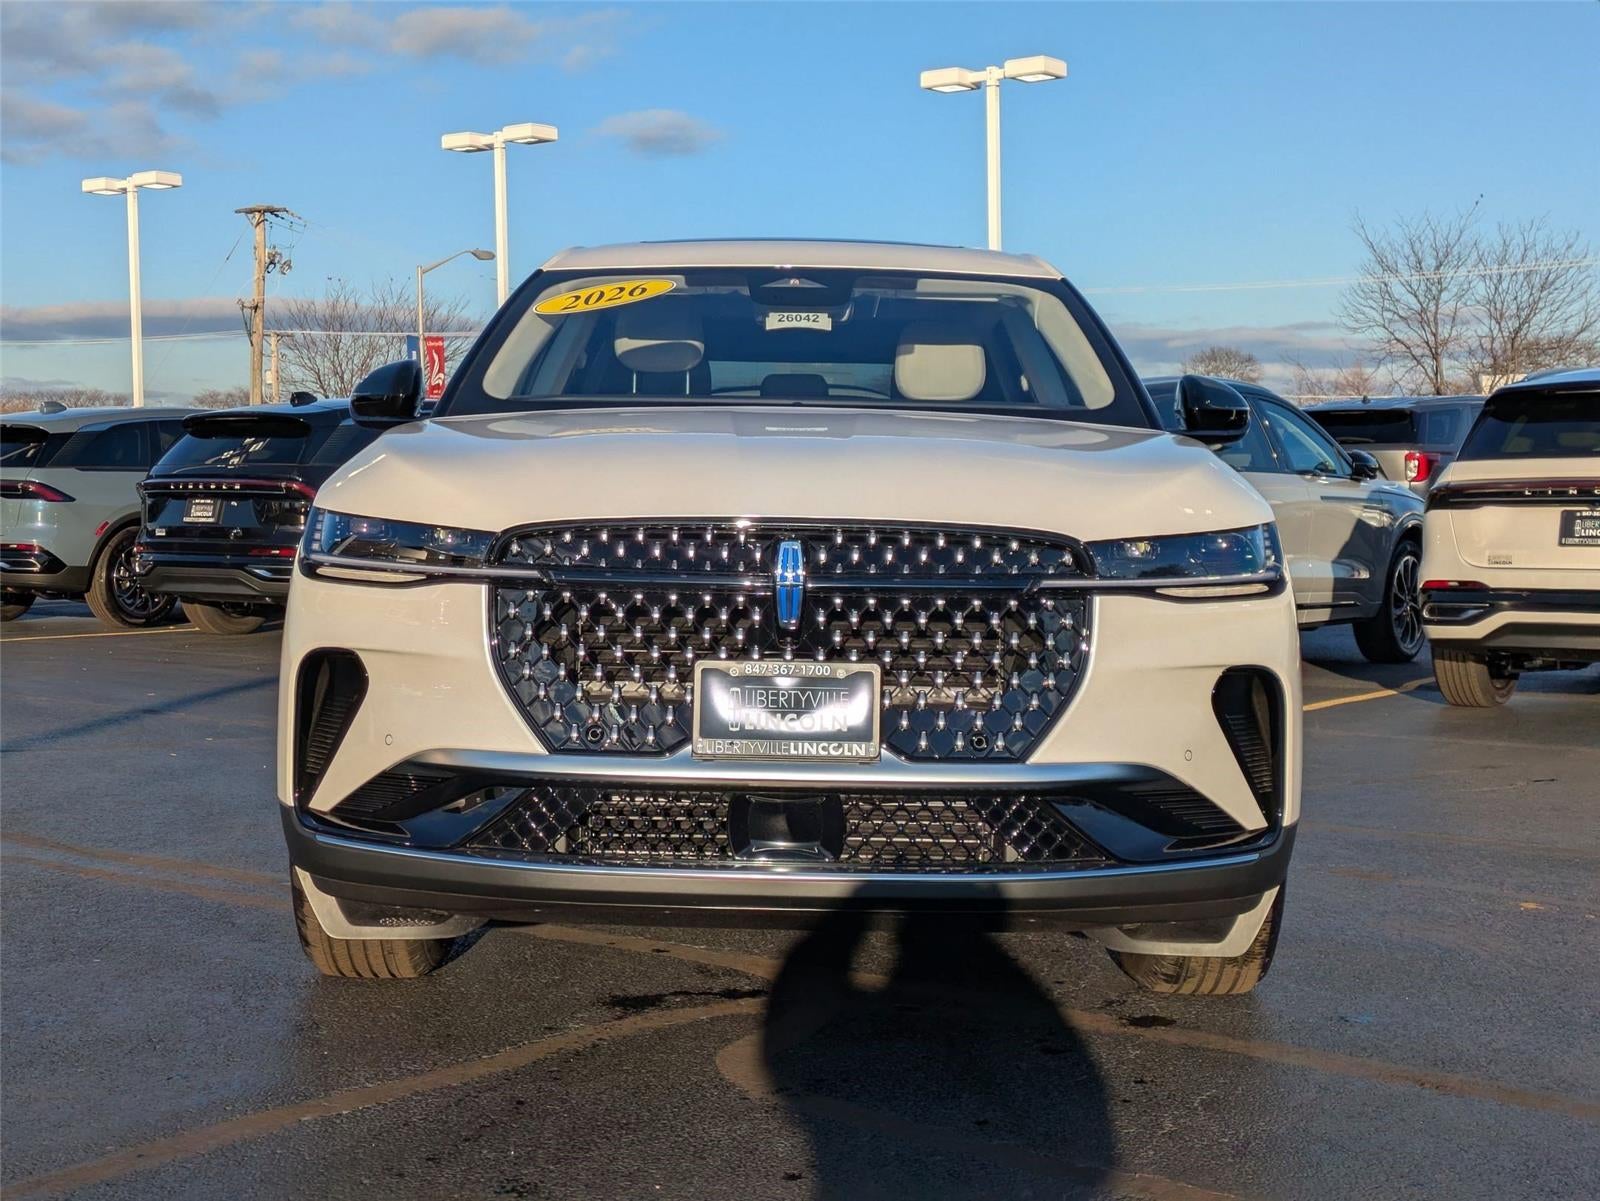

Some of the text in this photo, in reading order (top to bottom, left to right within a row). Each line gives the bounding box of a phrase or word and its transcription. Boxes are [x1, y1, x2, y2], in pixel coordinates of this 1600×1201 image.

[560, 282, 648, 311] 2026
[777, 313, 820, 323] 26042
[744, 664, 831, 676] 847-367-1700
[745, 690, 849, 708] LIBERTYVILLE
[744, 711, 848, 732] LINCOLN
